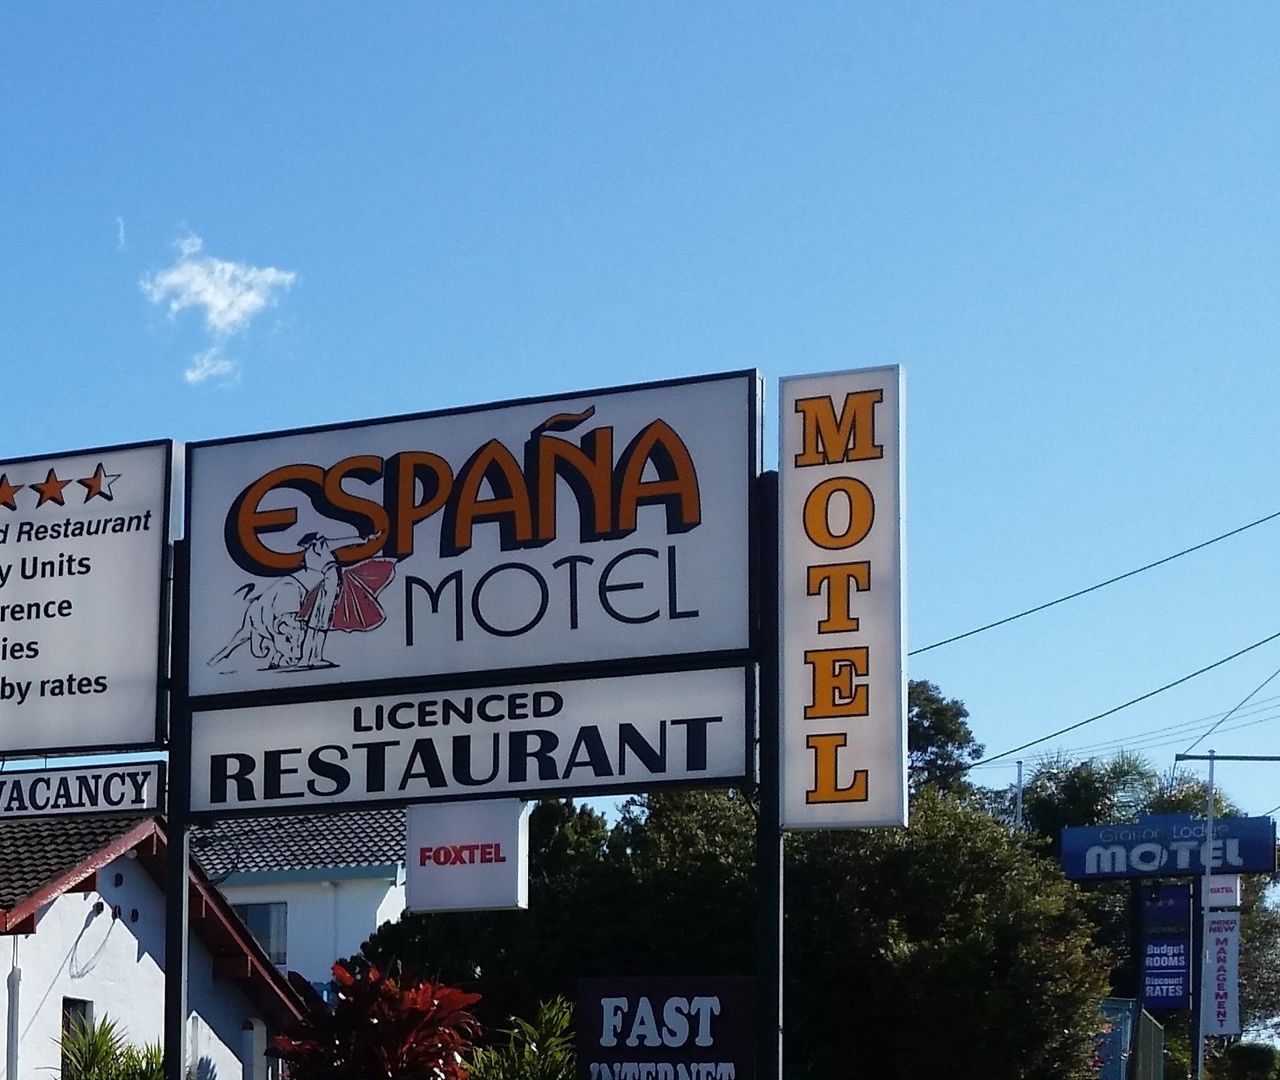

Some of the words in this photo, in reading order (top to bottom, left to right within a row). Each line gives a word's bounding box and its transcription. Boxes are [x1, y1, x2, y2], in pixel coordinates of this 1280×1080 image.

[224, 405, 701, 577] ESPAÑA
[16, 510, 152, 543] Restaurant
[20, 553, 92, 580] Units
[405, 546, 699, 647] MOTEL
[794, 388, 885, 805] MOTEL
[40, 673, 108, 697] rates
[352, 690, 564, 733] LICENCED
[208, 716, 723, 804] RESTAURANT
[419, 842, 507, 867] FOXTEL
[1145, 956, 1186, 967] ROOMS
[1146, 944, 1185, 956] Budget
[1145, 976, 1183, 985] Discount
[1145, 985, 1183, 997] RATES
[1215, 937, 1229, 1028] MANAGEMENT
[599, 996, 721, 1047] FAST
